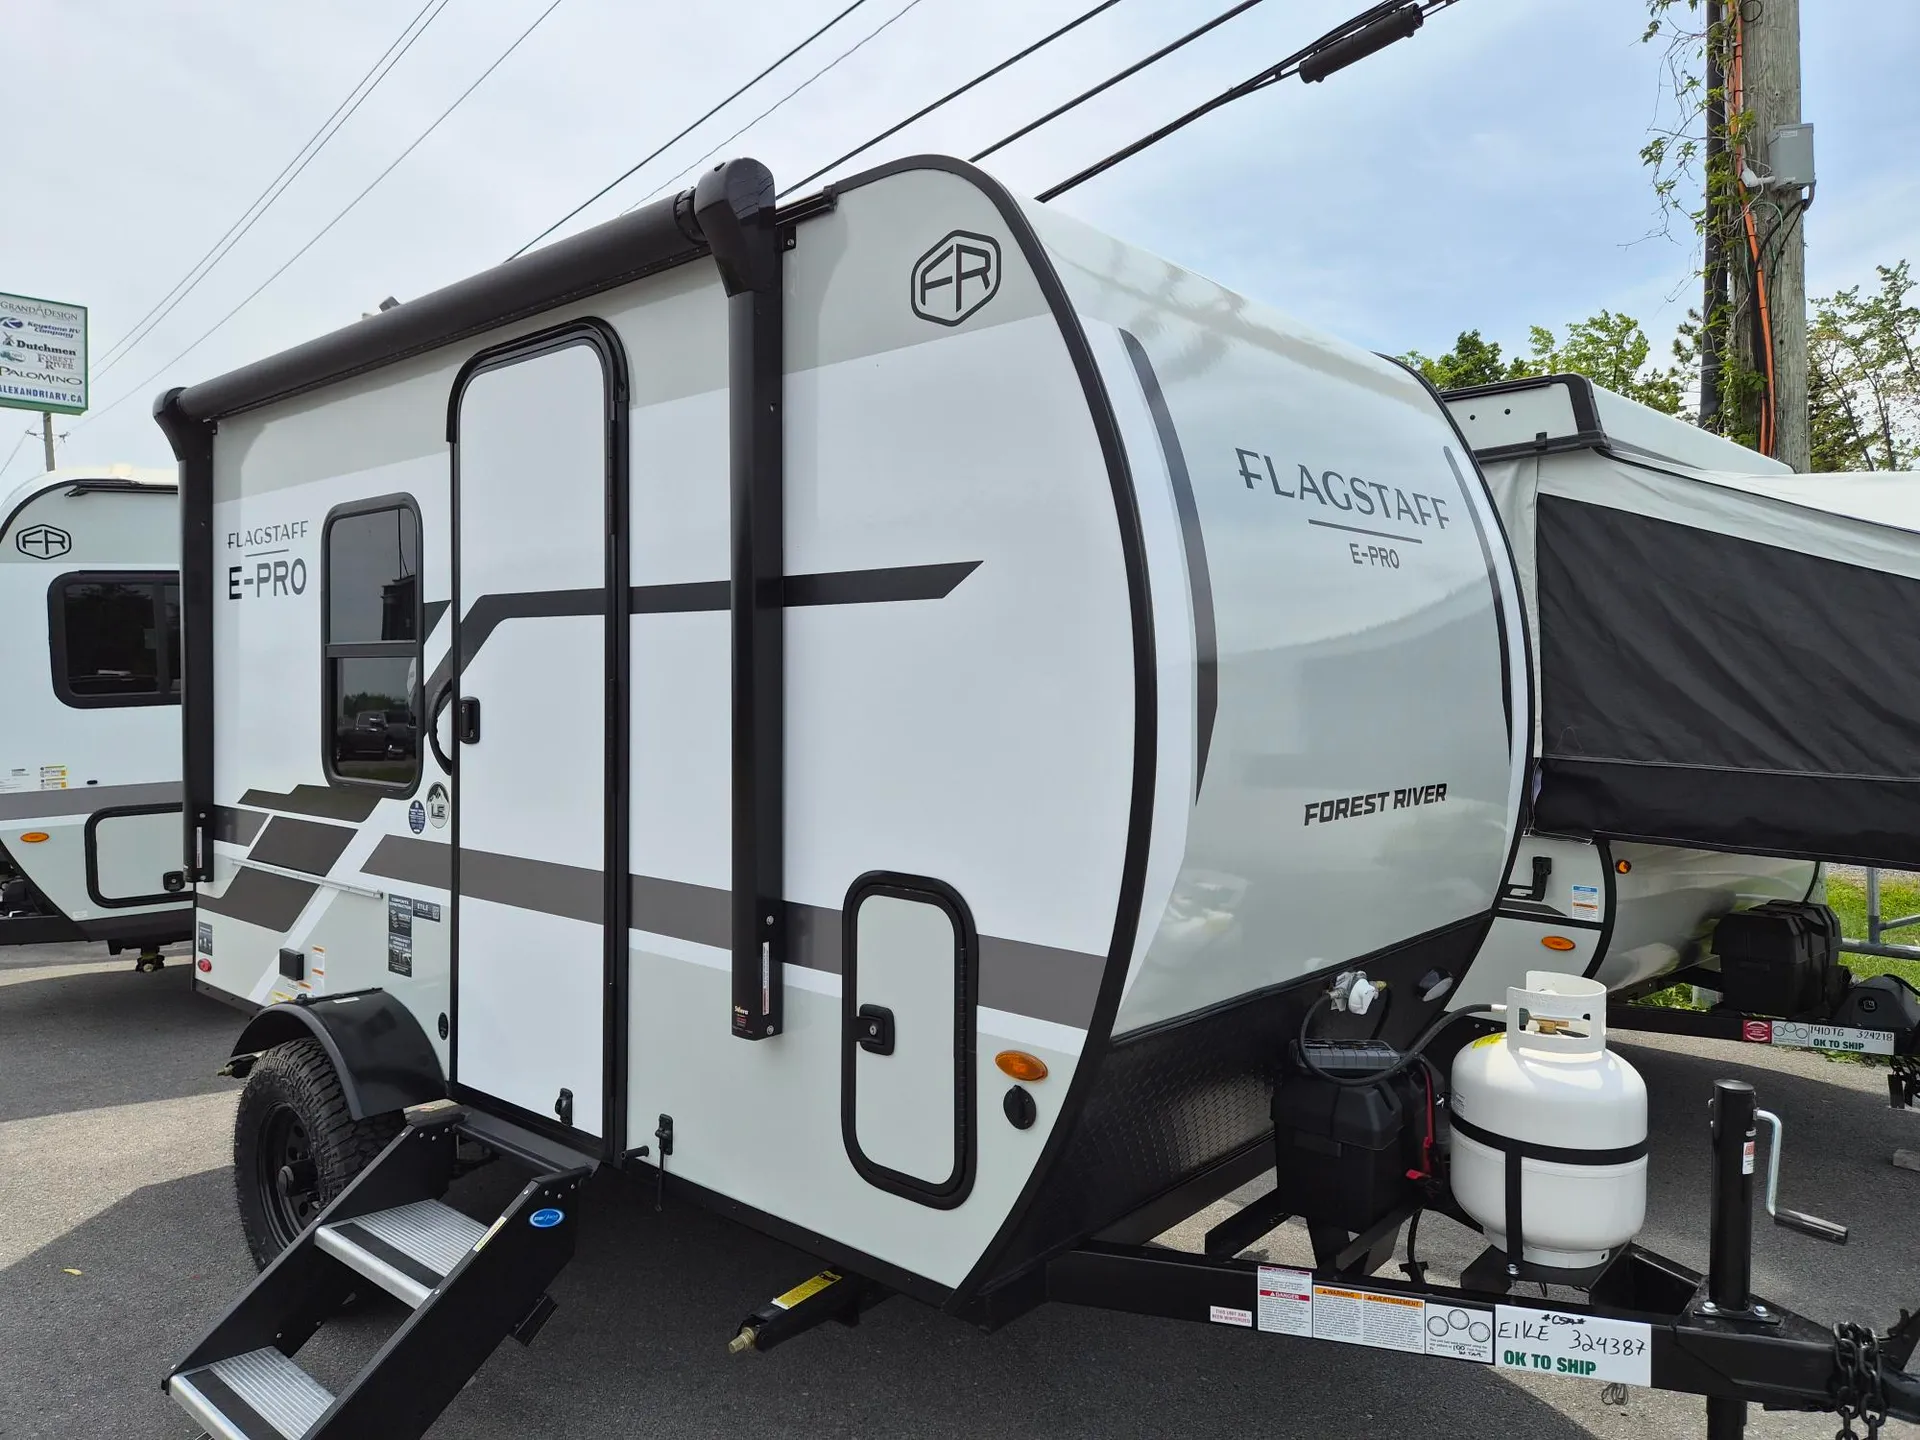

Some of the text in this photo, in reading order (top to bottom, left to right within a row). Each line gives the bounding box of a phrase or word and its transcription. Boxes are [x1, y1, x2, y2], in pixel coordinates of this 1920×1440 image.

[16, 340, 76, 356] Dutchmen
[0, 366, 83, 385] PALOMINO
[45, 361, 74, 370] RIVER
[1235, 447, 1450, 529] FLAGSTAFF
[227, 520, 309, 549] FLAGSTAFF
[1349, 543, 1400, 569] E-PRO
[229, 558, 307, 600] E-PRO
[1304, 783, 1448, 826] FOREST RIVER
[1813, 1038, 1826, 1047] OK
[1829, 1040, 1840, 1048] TO
[1842, 1041, 1865, 1050] SHIP
[1856, 1030, 1894, 1042] 324218
[1275, 1292, 1300, 1300] DANGER
[1326, 1289, 1355, 1299] WARNING
[1569, 1329, 1646, 1356] 324387
[1503, 1350, 1527, 1367] OK
[1531, 1353, 1551, 1370] TO
[1556, 1357, 1597, 1376] SHIP
